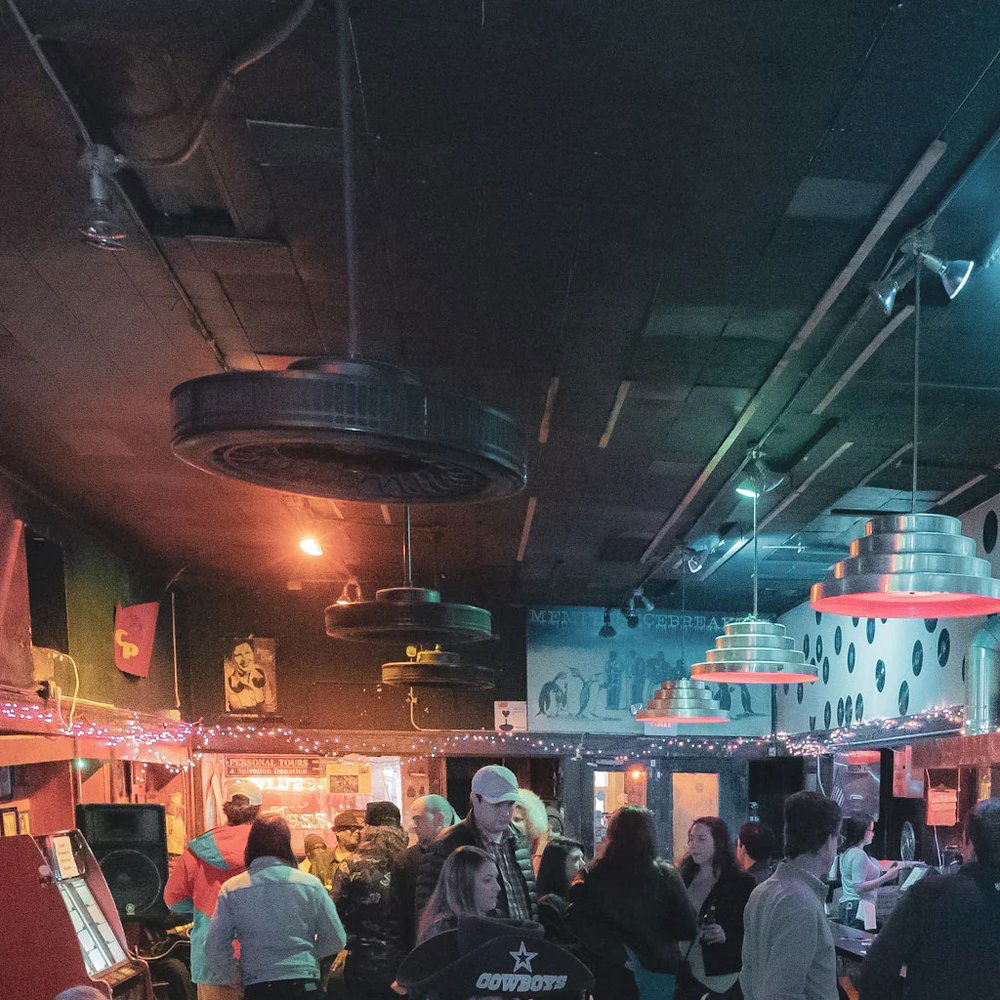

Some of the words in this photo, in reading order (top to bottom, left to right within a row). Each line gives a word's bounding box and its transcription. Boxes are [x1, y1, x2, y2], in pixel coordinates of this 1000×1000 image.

[229, 757, 276, 767] PERSONAL
[278, 757, 308, 767] TOURS
[273, 767, 308, 775] Donation
[475, 972, 568, 992] COWBOYS
